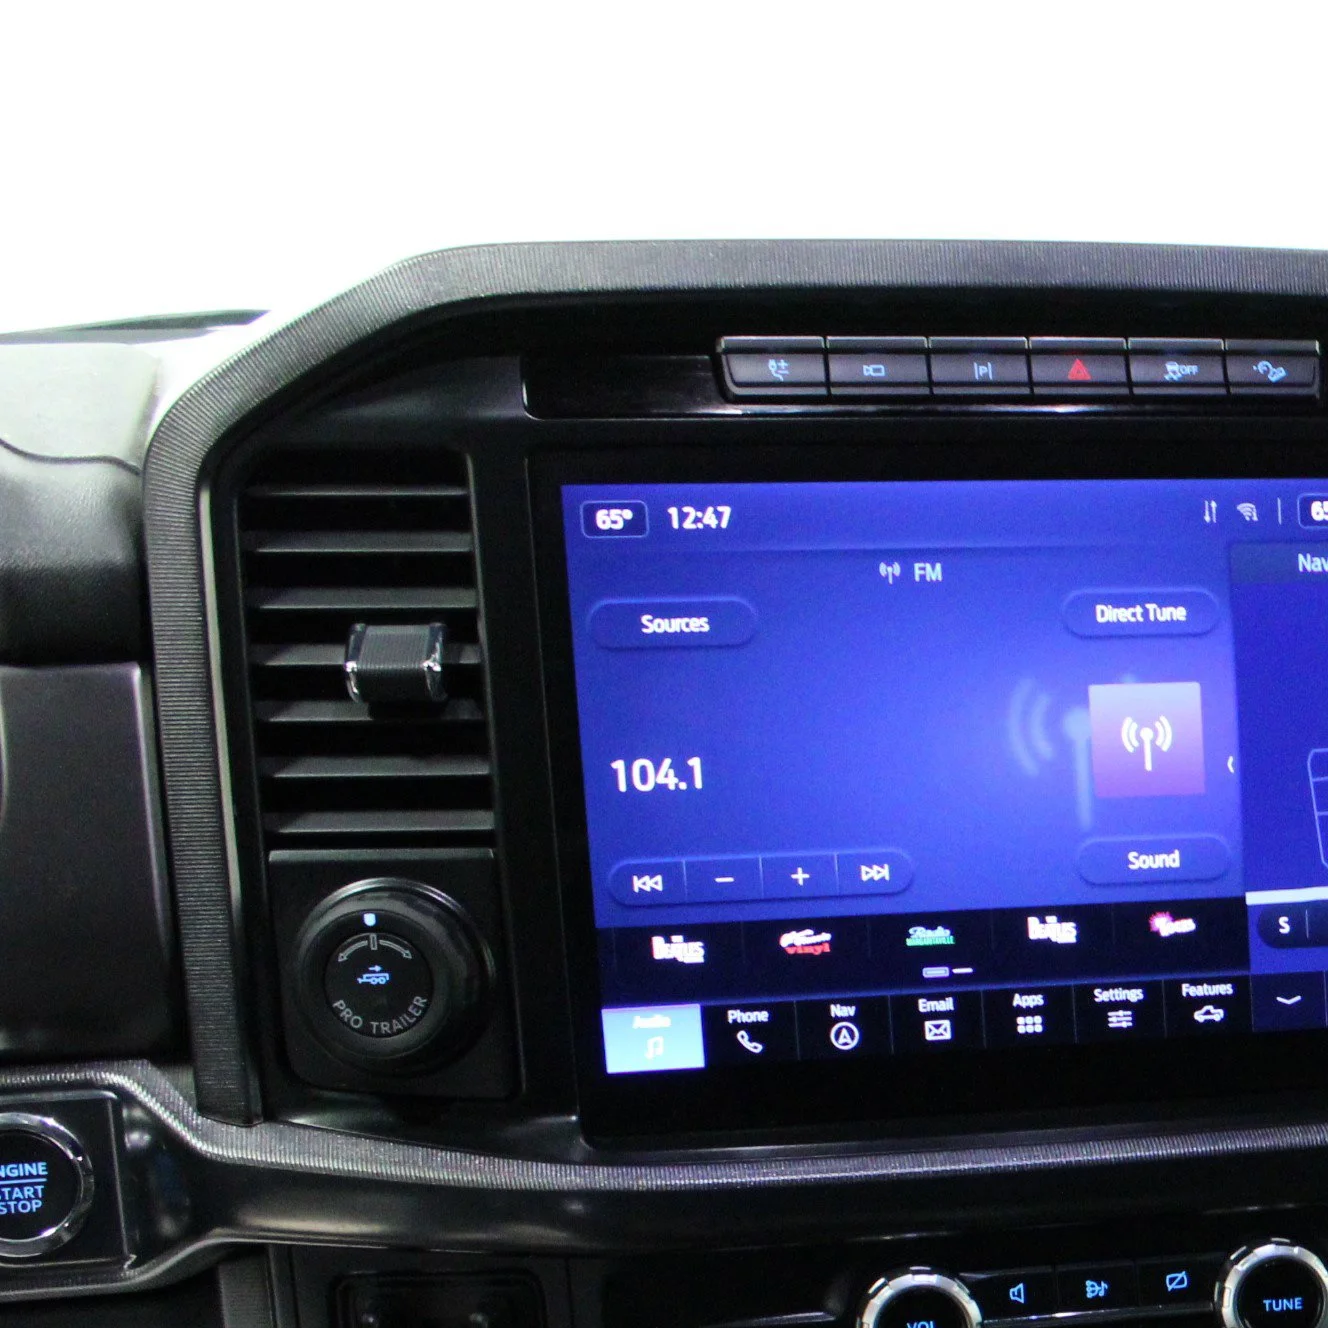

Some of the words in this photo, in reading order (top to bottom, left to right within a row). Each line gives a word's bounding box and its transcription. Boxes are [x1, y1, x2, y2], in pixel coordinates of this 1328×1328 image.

[596, 508, 634, 531] 65°
[668, 505, 732, 531] 12:47
[914, 562, 943, 582] FM
[1095, 603, 1144, 624] Direct
[1146, 602, 1187, 623] Tune
[641, 613, 710, 635] Sources
[610, 756, 704, 793] 104.1
[1128, 849, 1181, 871] Sound
[1278, 916, 1291, 935] S
[1093, 985, 1144, 1004] Settings
[1181, 980, 1234, 998] Features
[918, 996, 955, 1014] Email
[1012, 990, 1045, 1008] Apps
[331, 999, 364, 1030] PRO
[369, 995, 429, 1036] TRAILER
[727, 1008, 770, 1025] Phone
[830, 1003, 857, 1018] Nav
[0, 1161, 48, 1178] GINE
[0, 1185, 45, 1200] TART
[1262, 1296, 1304, 1314] TUNE
